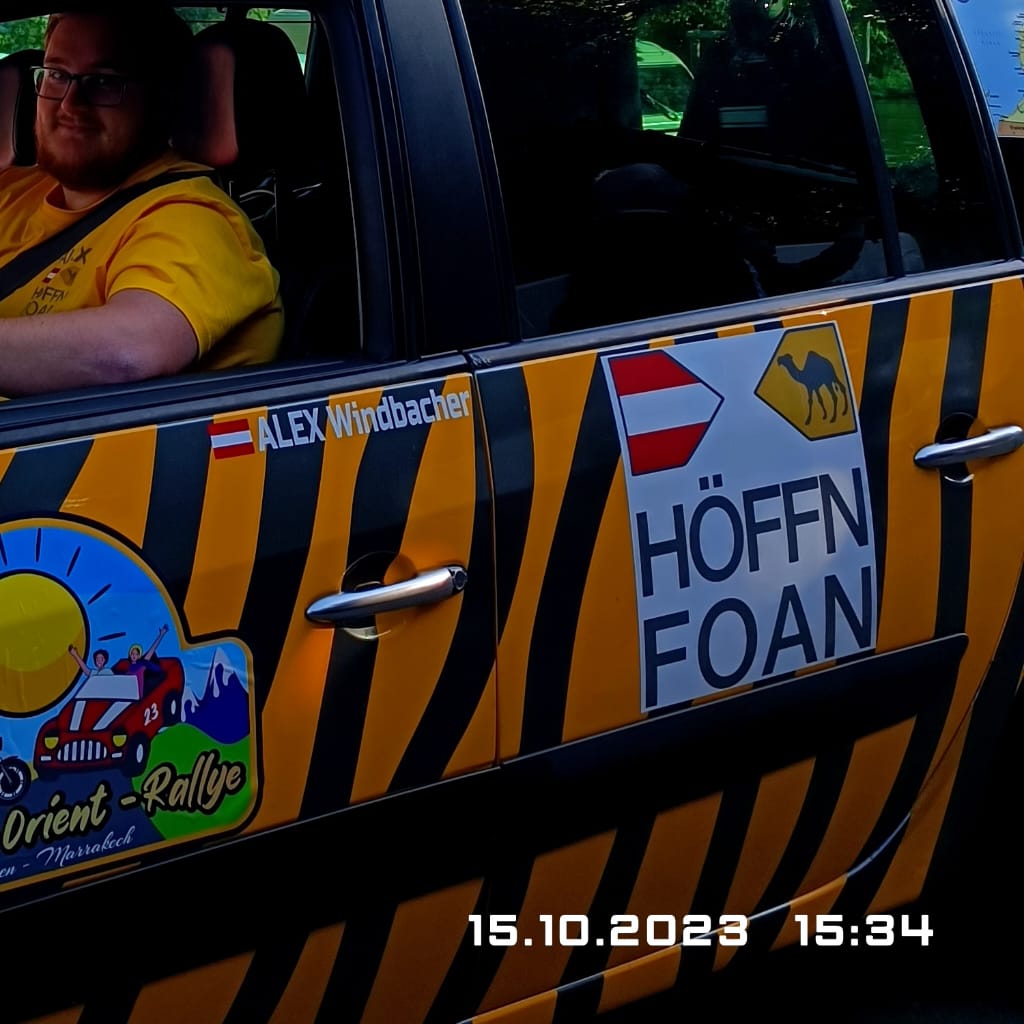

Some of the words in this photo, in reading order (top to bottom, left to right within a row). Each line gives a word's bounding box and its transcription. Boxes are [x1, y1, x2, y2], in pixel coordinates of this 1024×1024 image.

[257, 407, 326, 452] ALEX
[326, 388, 471, 440] Windbacher
[636, 467, 870, 598] HÖFFN
[643, 566, 872, 708] FOAN
[143, 702, 160, 726] 23
[35, 825, 136, 868] Marrakech
